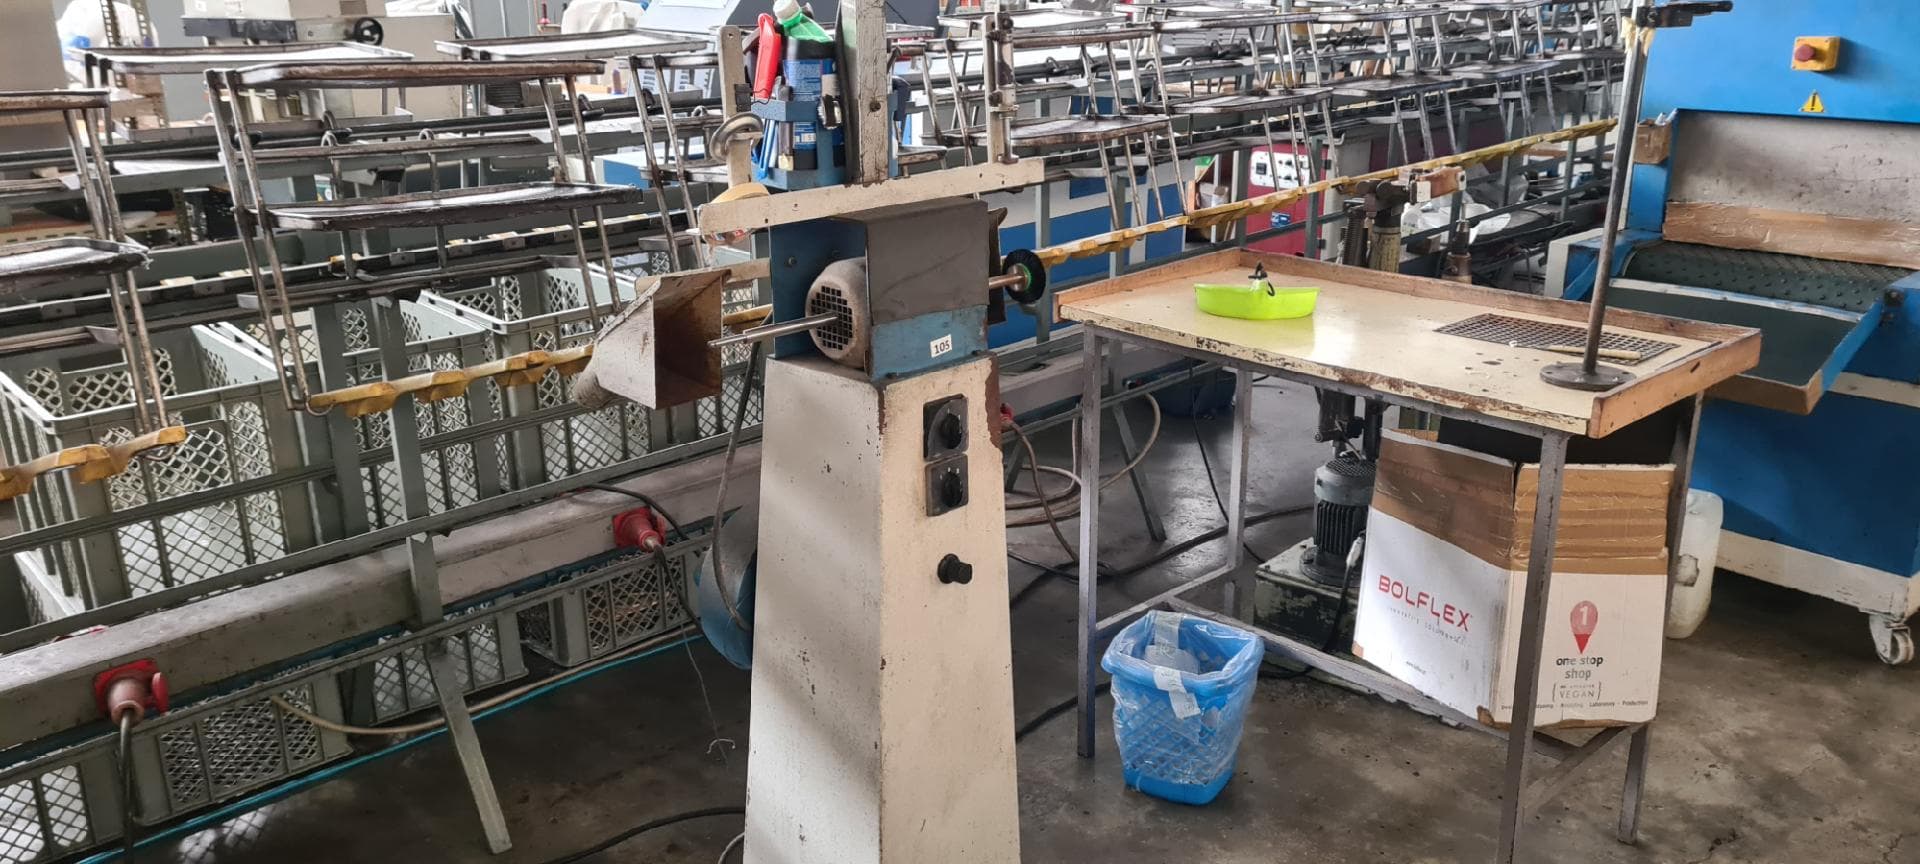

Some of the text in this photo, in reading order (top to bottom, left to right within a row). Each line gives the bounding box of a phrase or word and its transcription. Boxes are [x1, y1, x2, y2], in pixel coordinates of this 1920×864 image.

[934, 339, 950, 354] 105
[1379, 575, 1469, 632] BOLFLEX
[1580, 605, 1588, 625] 1
[1556, 656, 1603, 667] one stop
[1564, 668, 1591, 680] shop
[1560, 690, 1594, 698] VEGAN
